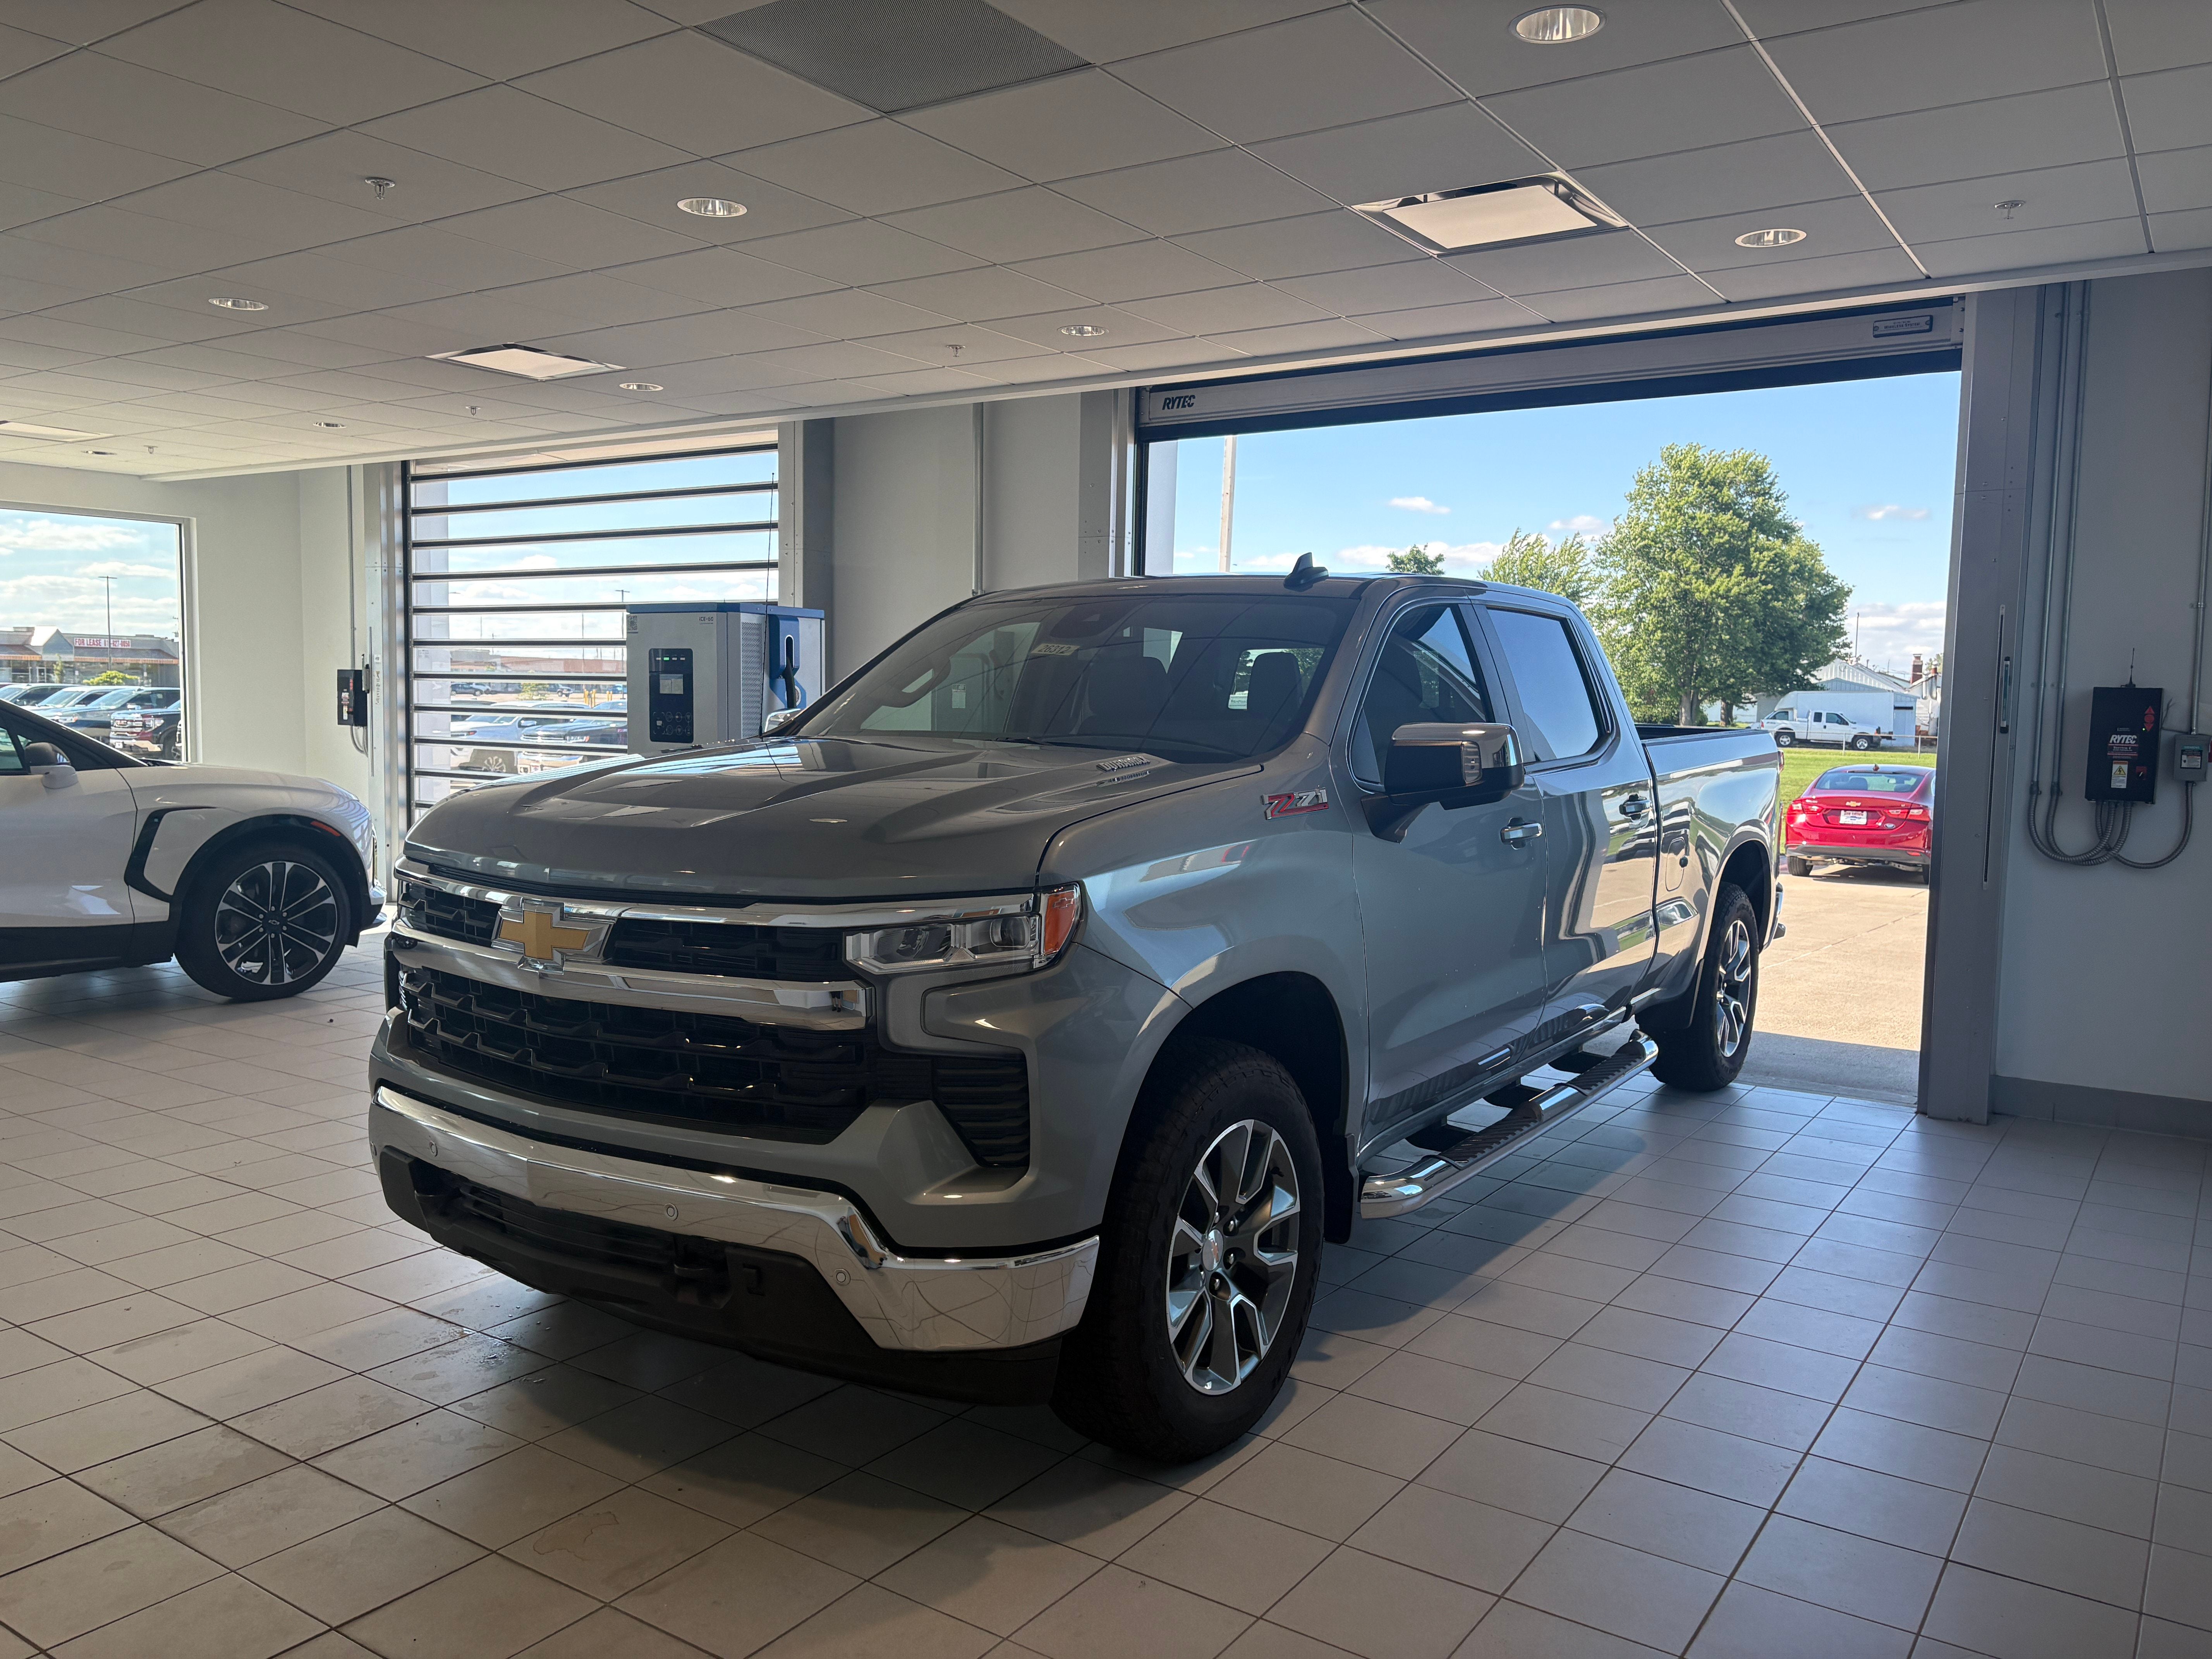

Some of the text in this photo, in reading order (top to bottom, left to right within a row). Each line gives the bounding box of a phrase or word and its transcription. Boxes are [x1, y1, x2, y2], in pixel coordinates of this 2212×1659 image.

[1162, 395, 1195, 410] RYTEC
[1038, 645, 1071, 654] 26312
[2109, 735, 2137, 744] RYTEC
[1096, 756, 1151, 772] DURAMAX
[1260, 787, 1329, 820] Z71
